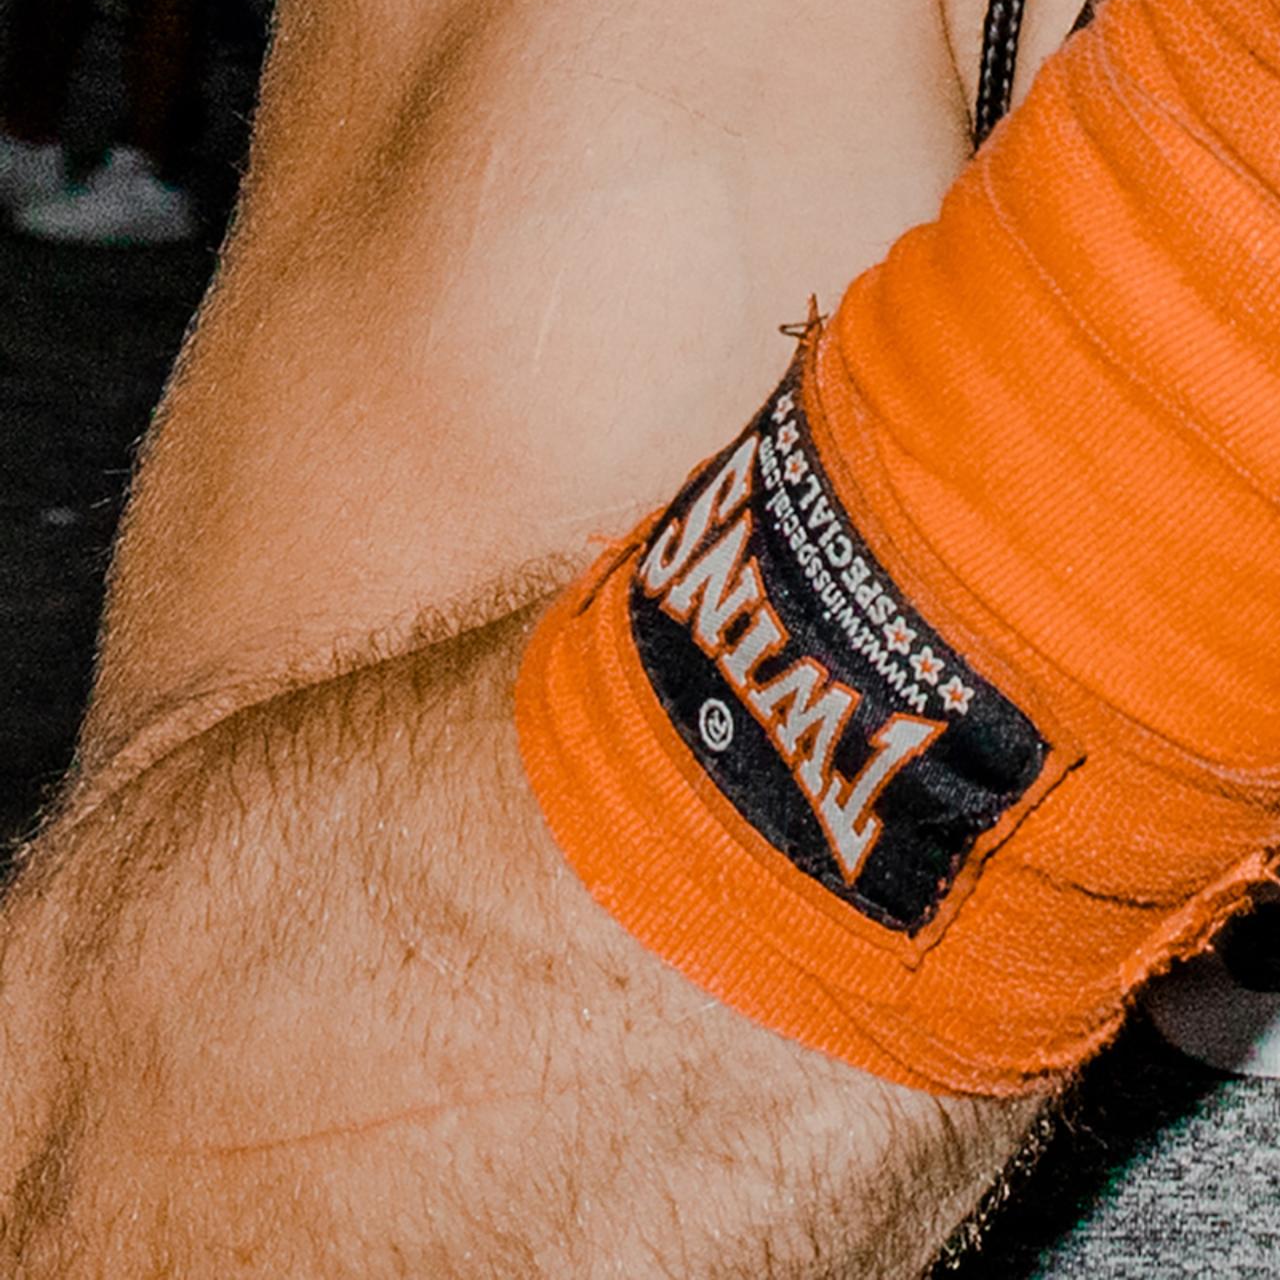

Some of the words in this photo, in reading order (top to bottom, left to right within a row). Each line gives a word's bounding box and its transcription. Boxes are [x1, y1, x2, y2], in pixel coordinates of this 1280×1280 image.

[637, 433, 947, 886] TWINS
[758, 435, 929, 713] www.twinsspecial.com
[799, 474, 898, 626] SPECIAL
